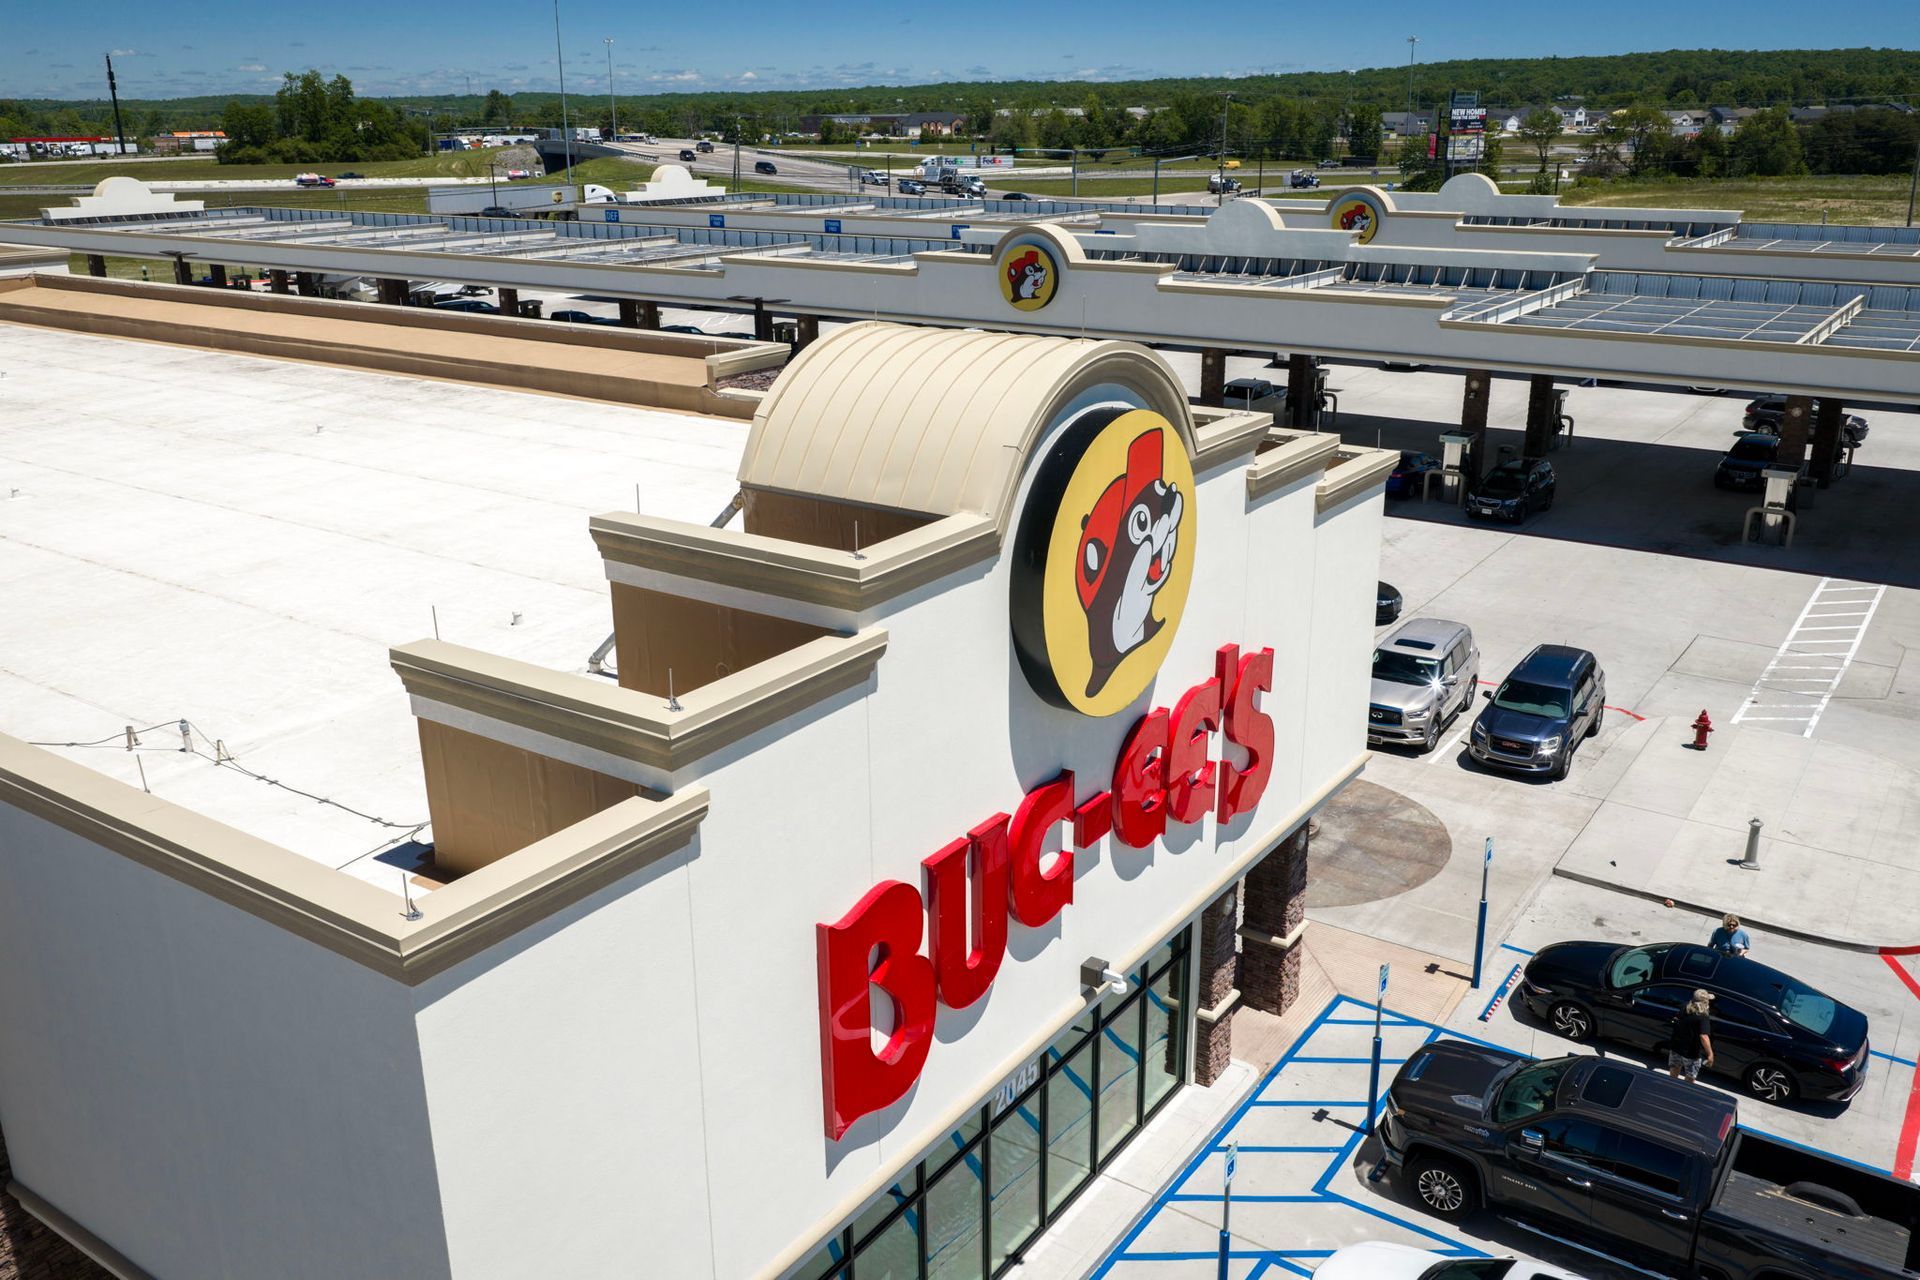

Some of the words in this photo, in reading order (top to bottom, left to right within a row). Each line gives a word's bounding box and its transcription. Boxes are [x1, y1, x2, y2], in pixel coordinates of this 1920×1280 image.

[1451, 108, 1466, 116] NEW
[944, 157, 964, 166] FedEx
[982, 157, 1002, 165] FedEx
[606, 211, 619, 221] DEF
[995, 1061, 1038, 1116] 2045
